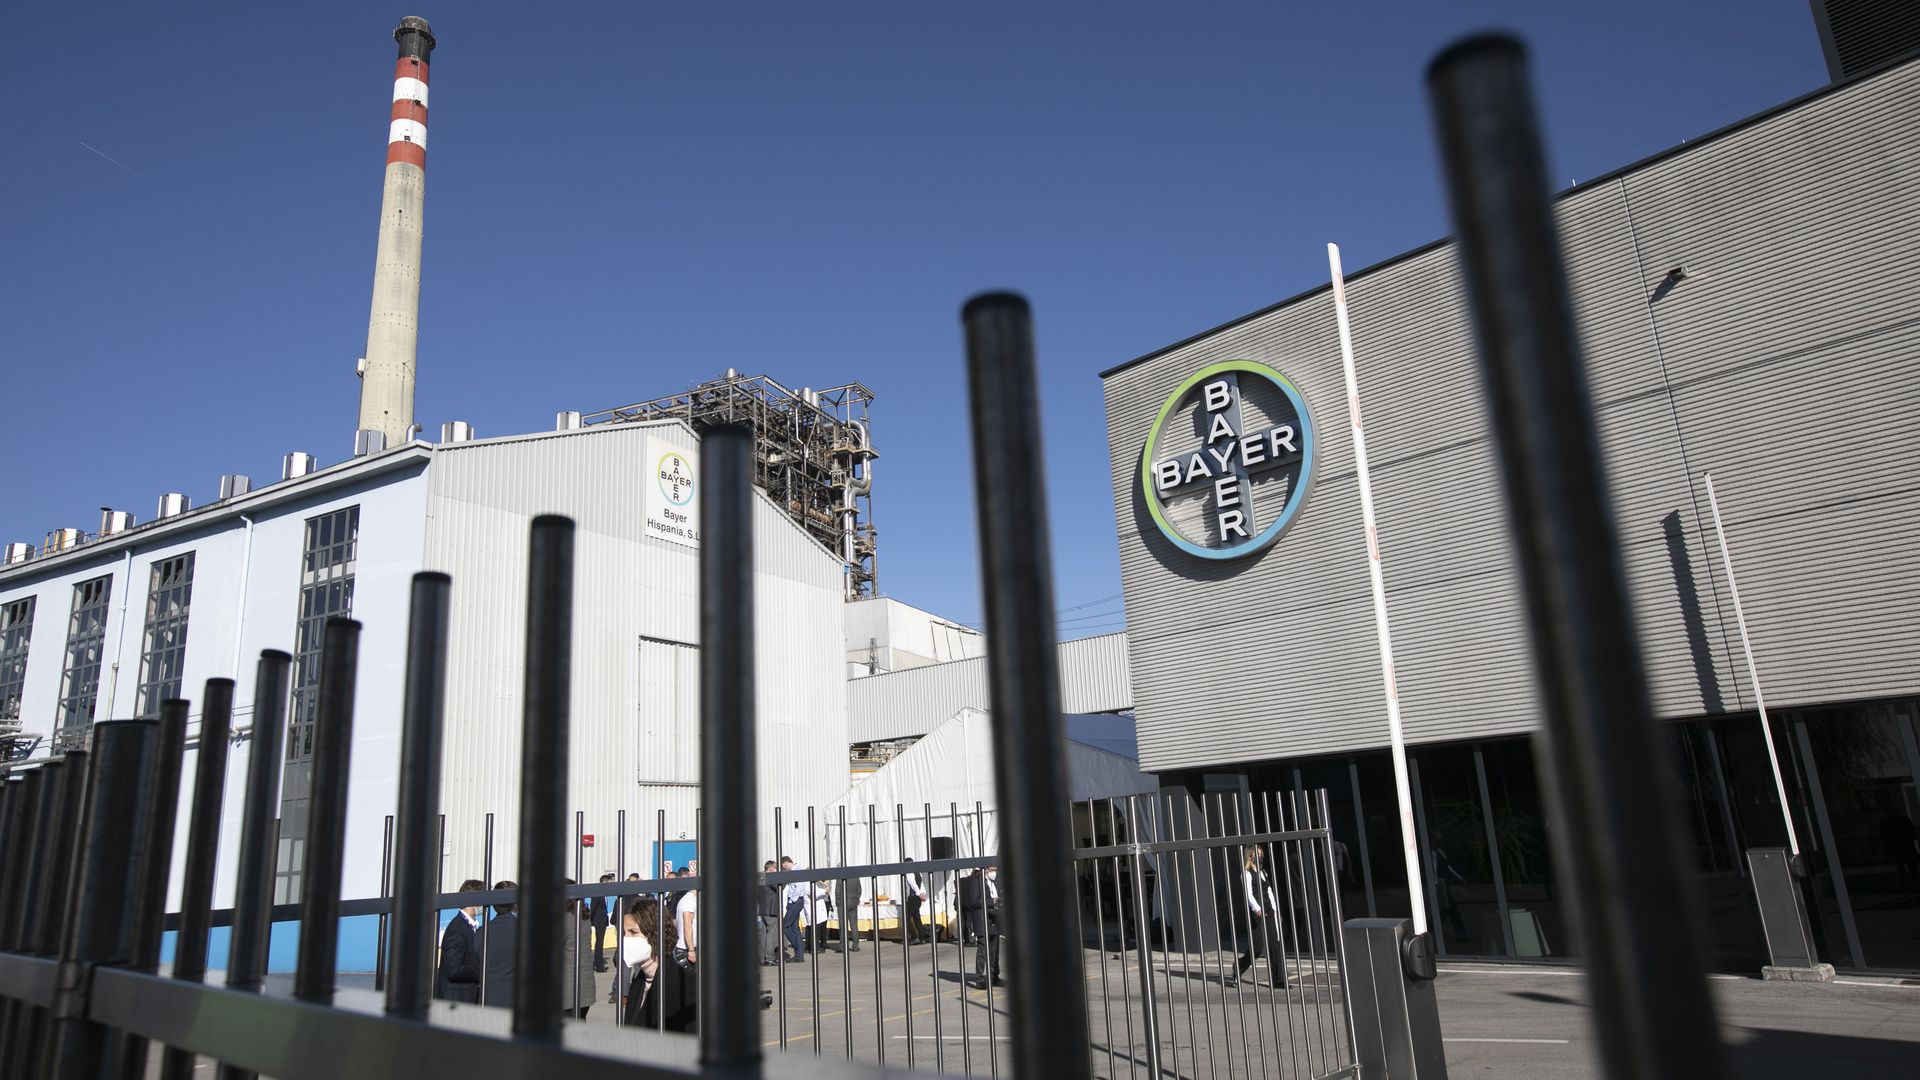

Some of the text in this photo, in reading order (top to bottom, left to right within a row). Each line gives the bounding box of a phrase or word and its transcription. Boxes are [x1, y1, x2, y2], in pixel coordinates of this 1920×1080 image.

[1157, 425, 1297, 491] BAYER
[1204, 380, 1248, 542] BAYER
[661, 470, 691, 488] BAYER
[664, 508, 687, 523] Bayer
[647, 518, 686, 538] Hispania,
